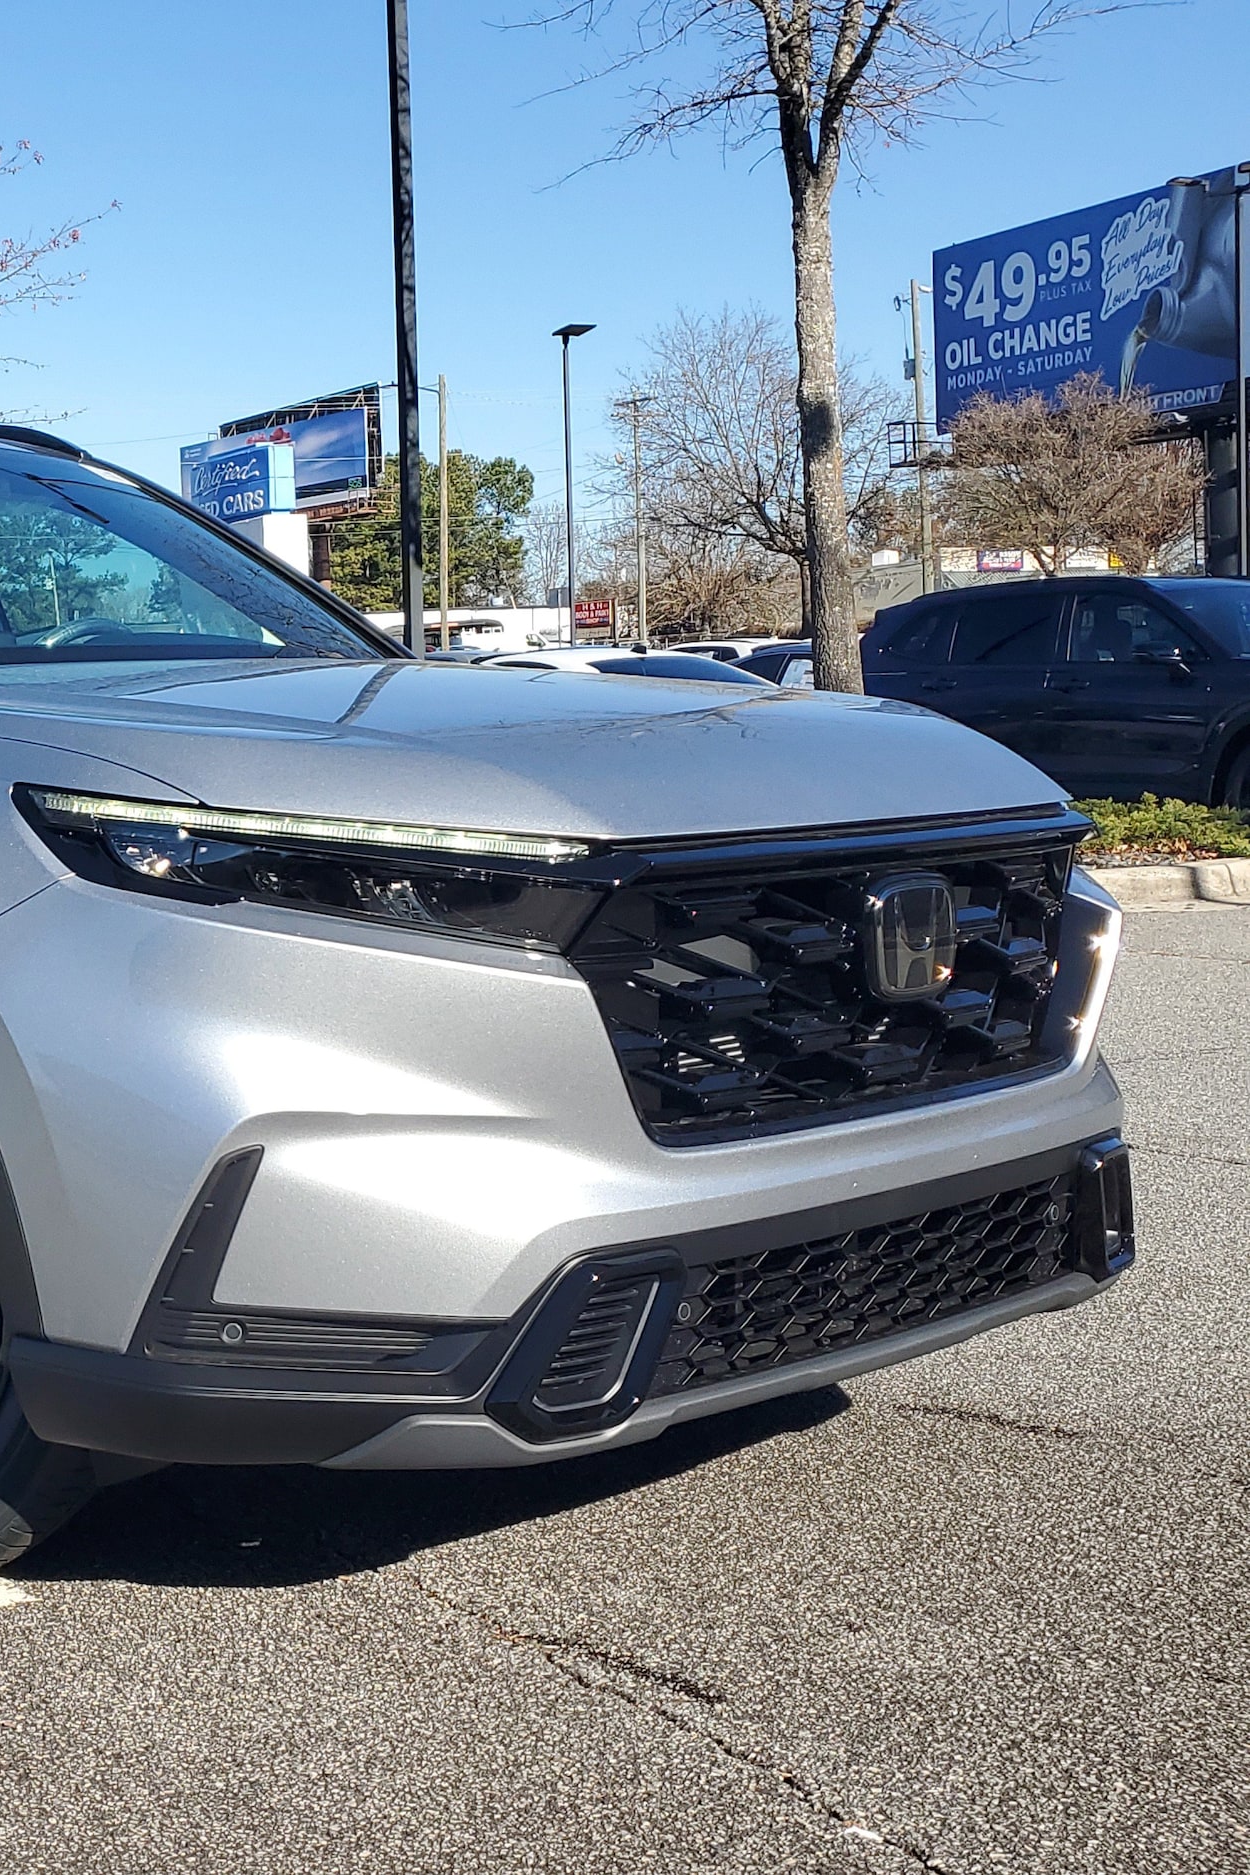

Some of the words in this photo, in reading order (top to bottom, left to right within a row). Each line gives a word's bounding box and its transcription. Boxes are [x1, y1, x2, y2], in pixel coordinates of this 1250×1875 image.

[1104, 216, 1130, 256] All
[1135, 202, 1168, 233] Day
[1104, 232, 1166, 285] Everyday
[1039, 285, 1067, 302] PLUS
[1071, 279, 1092, 296] TAX
[1102, 288, 1131, 317] Low
[945, 337, 982, 371] OIL
[988, 310, 1092, 361] CHANGE
[947, 364, 1003, 391] MONDAY
[1017, 346, 1093, 376] SATURDAY
[192, 458, 260, 496] Certified
[223, 489, 264, 515] CARS
